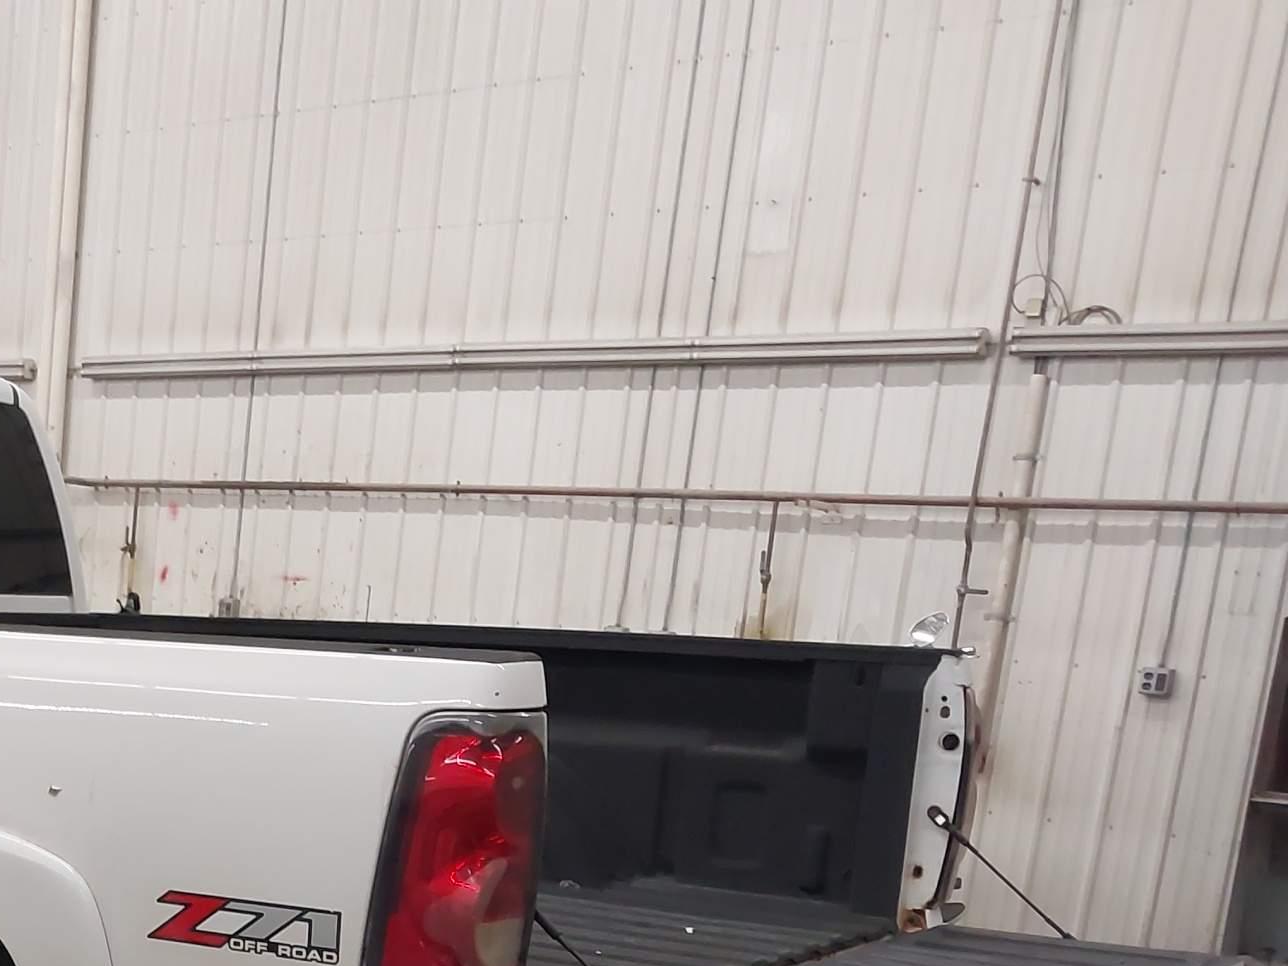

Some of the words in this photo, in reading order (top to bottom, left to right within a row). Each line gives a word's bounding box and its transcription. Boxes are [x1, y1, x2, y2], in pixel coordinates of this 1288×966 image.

[147, 890, 341, 950] Z71
[229, 937, 268, 953] OFF
[277, 945, 338, 965] ROAD
